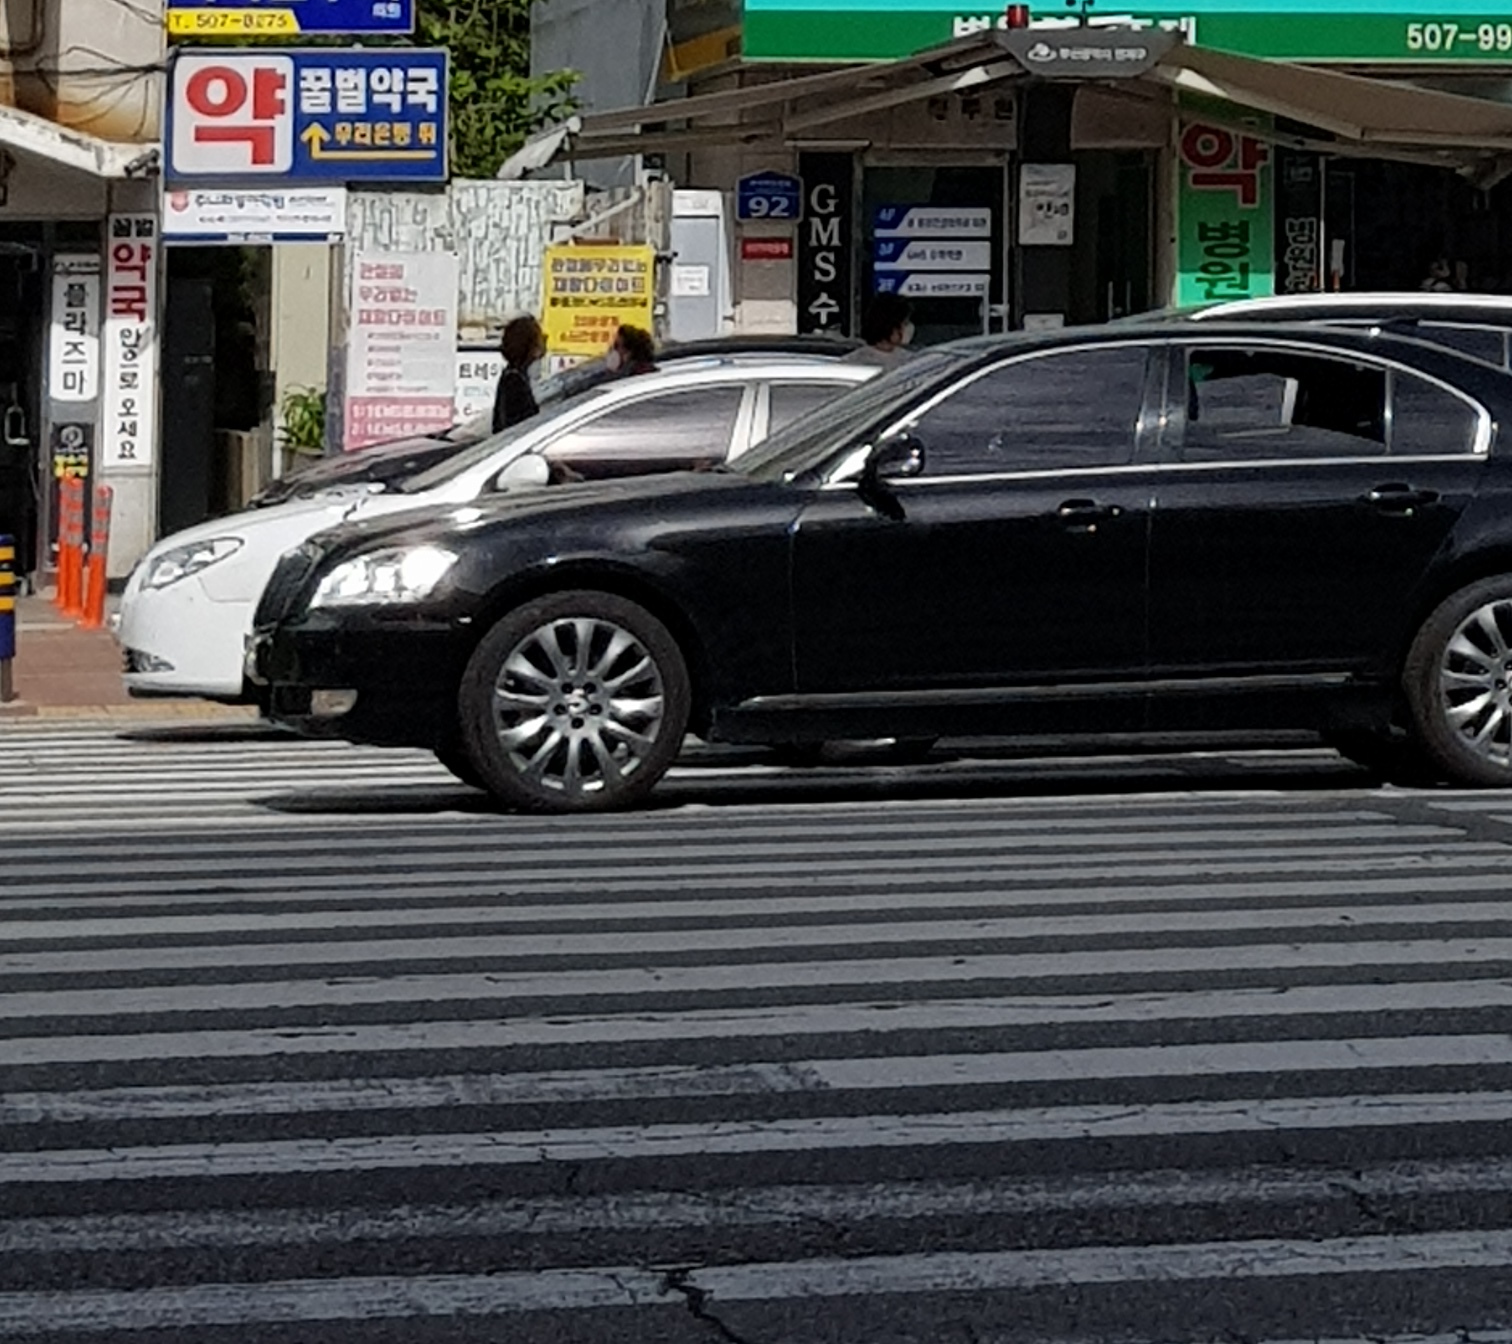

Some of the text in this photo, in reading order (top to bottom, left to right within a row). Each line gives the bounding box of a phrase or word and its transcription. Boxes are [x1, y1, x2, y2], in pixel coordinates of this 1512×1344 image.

[185, 65, 287, 166] 약
[334, 122, 412, 146] 우리은행
[1181, 121, 1270, 209] 약
[747, 196, 790, 218] 92
[117, 398, 139, 460] 오세요
